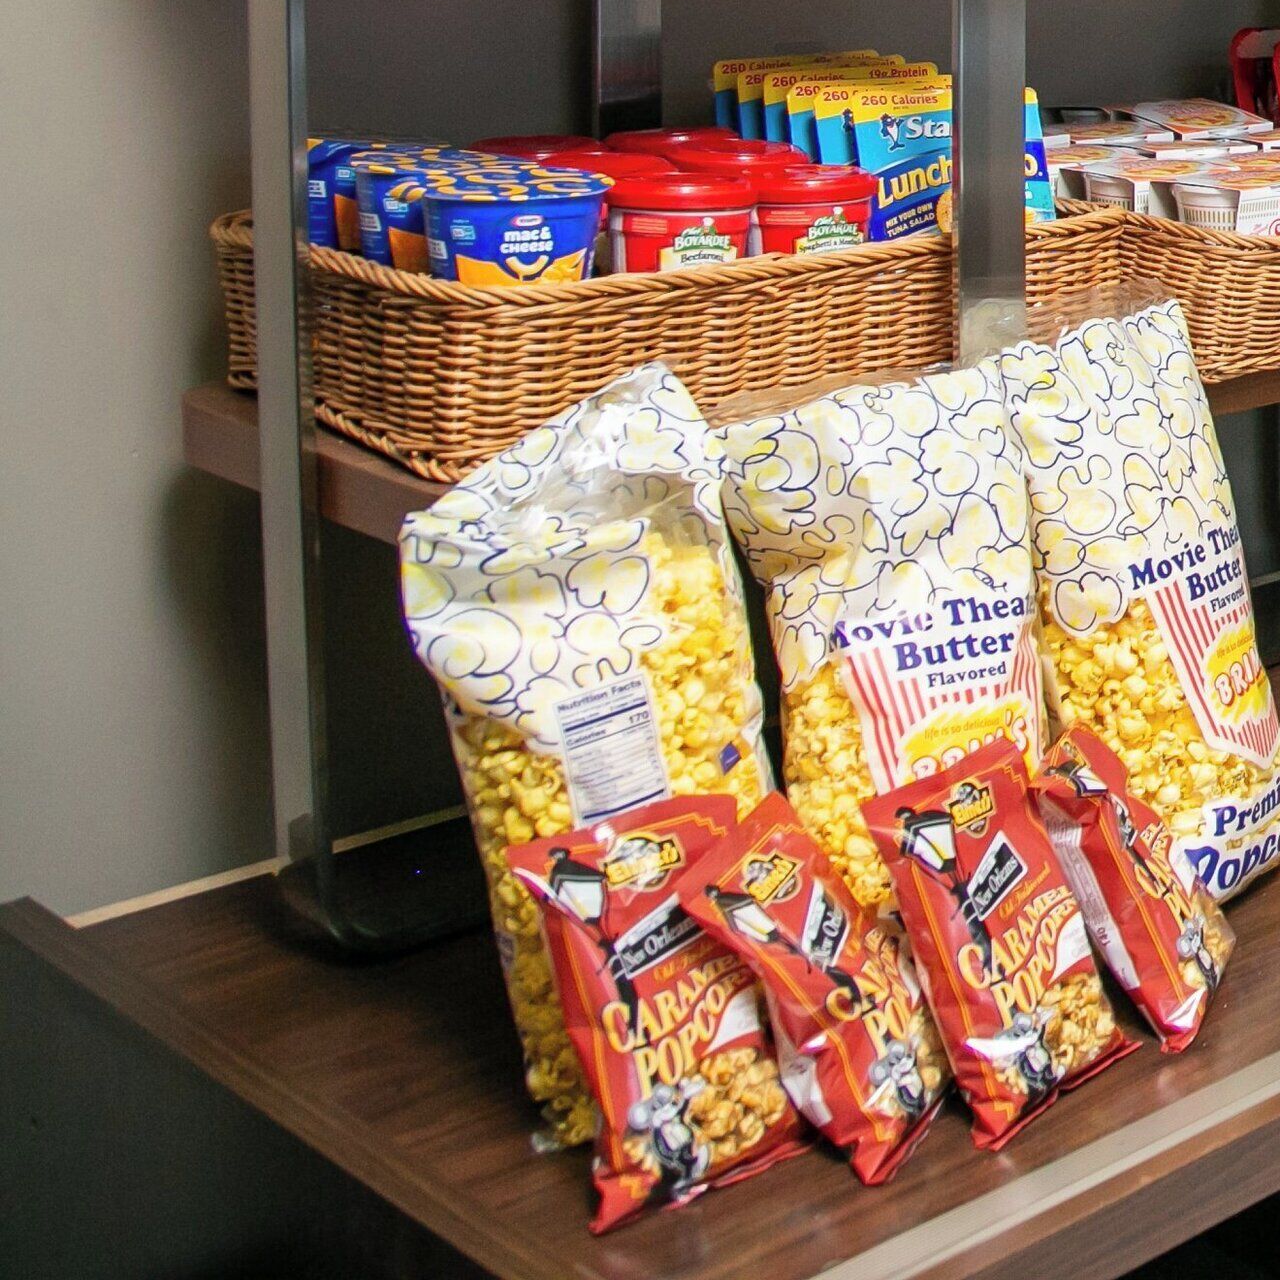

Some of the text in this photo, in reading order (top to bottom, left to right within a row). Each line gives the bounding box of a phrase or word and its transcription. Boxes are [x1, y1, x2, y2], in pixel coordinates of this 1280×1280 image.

[722, 63, 747, 75] 260
[772, 76, 796, 87] 260
[891, 66, 929, 78] Protein
[823, 90, 849, 102] 260
[861, 92, 939, 106] 260 Calories
[886, 202, 933, 229] MIX YOUR OWN
[887, 212, 935, 238] TUNA SALAD
[674, 234, 731, 251] BOYARDEE
[808, 222, 860, 240] BOYARDEE
[1128, 542, 1206, 591] Movie
[1186, 557, 1243, 601] Butter
[1210, 583, 1245, 613] Flavored
[894, 631, 1015, 671] Butter
[927, 661, 1007, 688] Flavored
[558, 680, 642, 712] Nutrition Facts
[628, 710, 650, 723] 170
[973, 855, 1020, 912] New Orleans
[958, 885, 1073, 990] CARAMEL
[602, 953, 738, 1053] CARAME
[634, 972, 747, 1099] POPCOR
